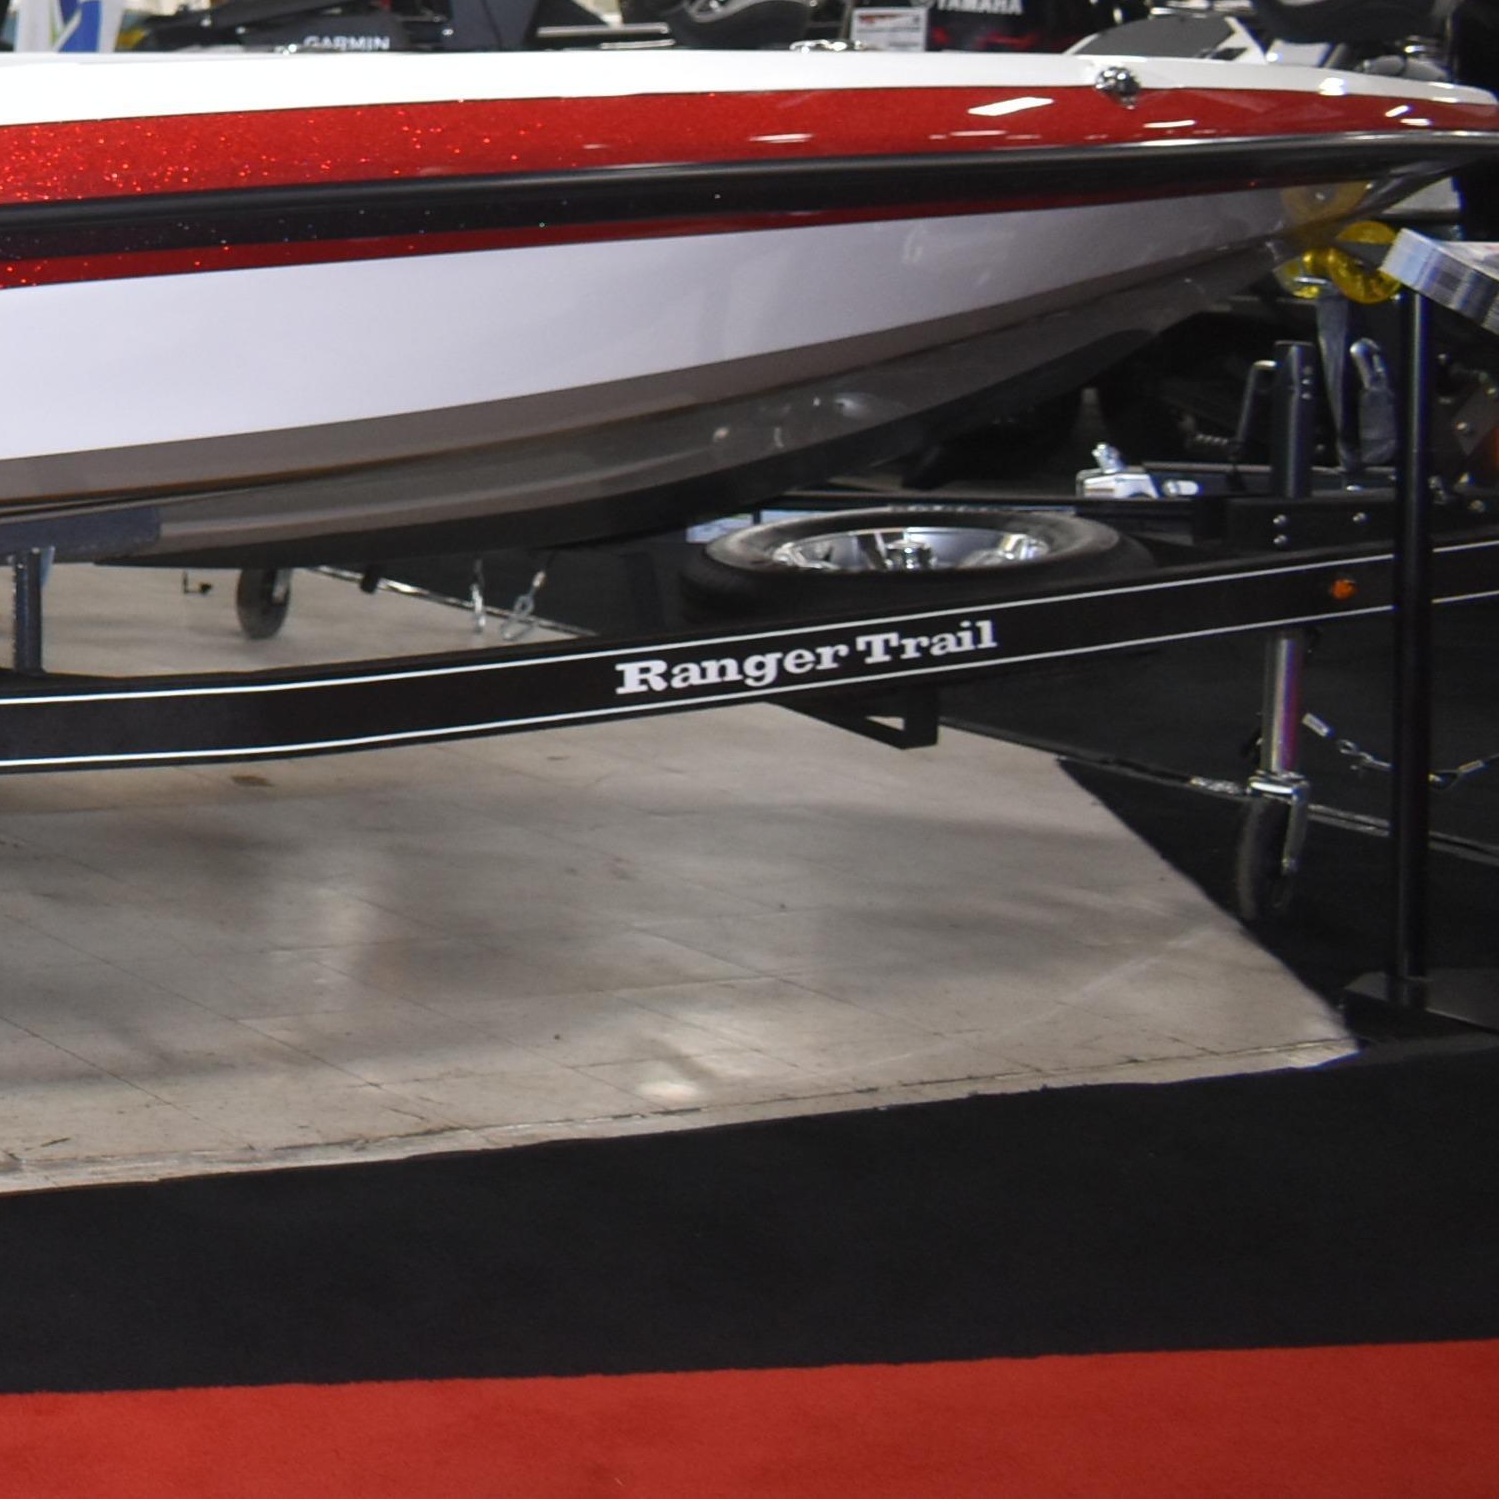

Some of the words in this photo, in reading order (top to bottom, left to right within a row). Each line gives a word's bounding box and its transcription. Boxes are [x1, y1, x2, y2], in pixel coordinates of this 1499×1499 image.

[303, 35, 390, 51] GARMIN
[615, 643, 849, 694] Ranger
[855, 619, 998, 665] Trail
